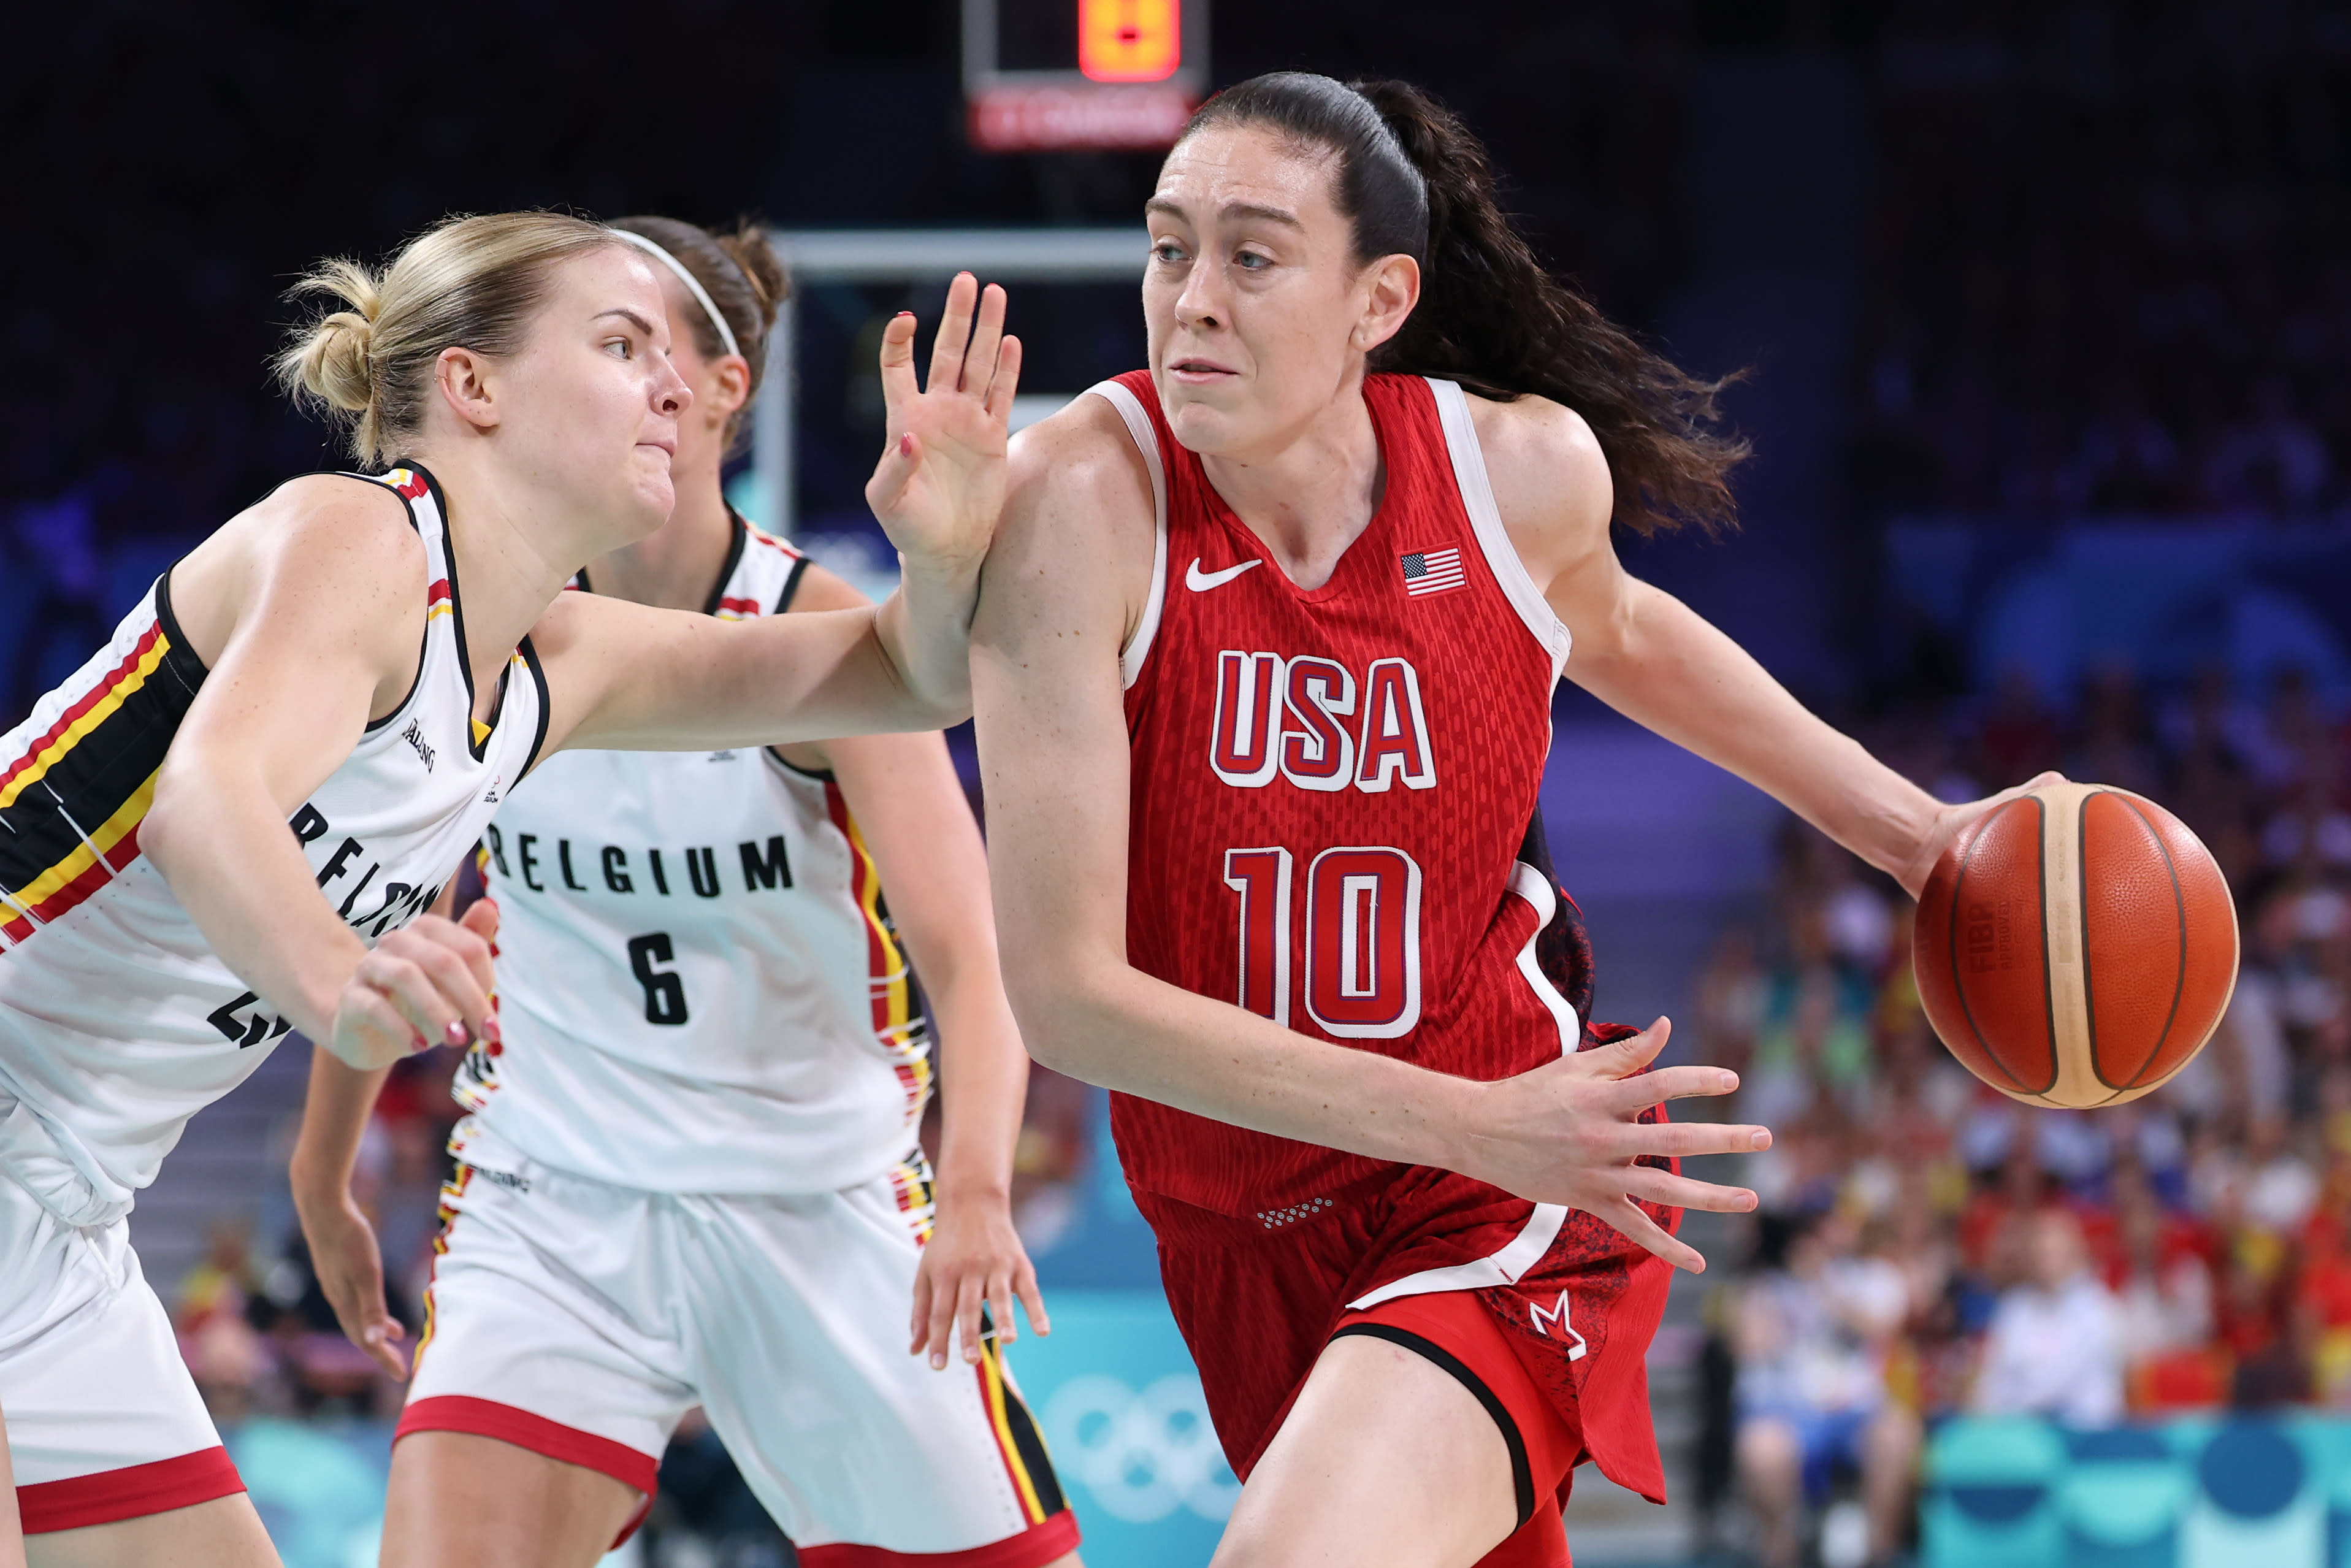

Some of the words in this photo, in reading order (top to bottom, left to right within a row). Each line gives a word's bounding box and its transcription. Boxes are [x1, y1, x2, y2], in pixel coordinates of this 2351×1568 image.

[1209, 650, 1437, 793] USA
[628, 932, 689, 1025] 6
[1224, 846, 1422, 1039] 10
